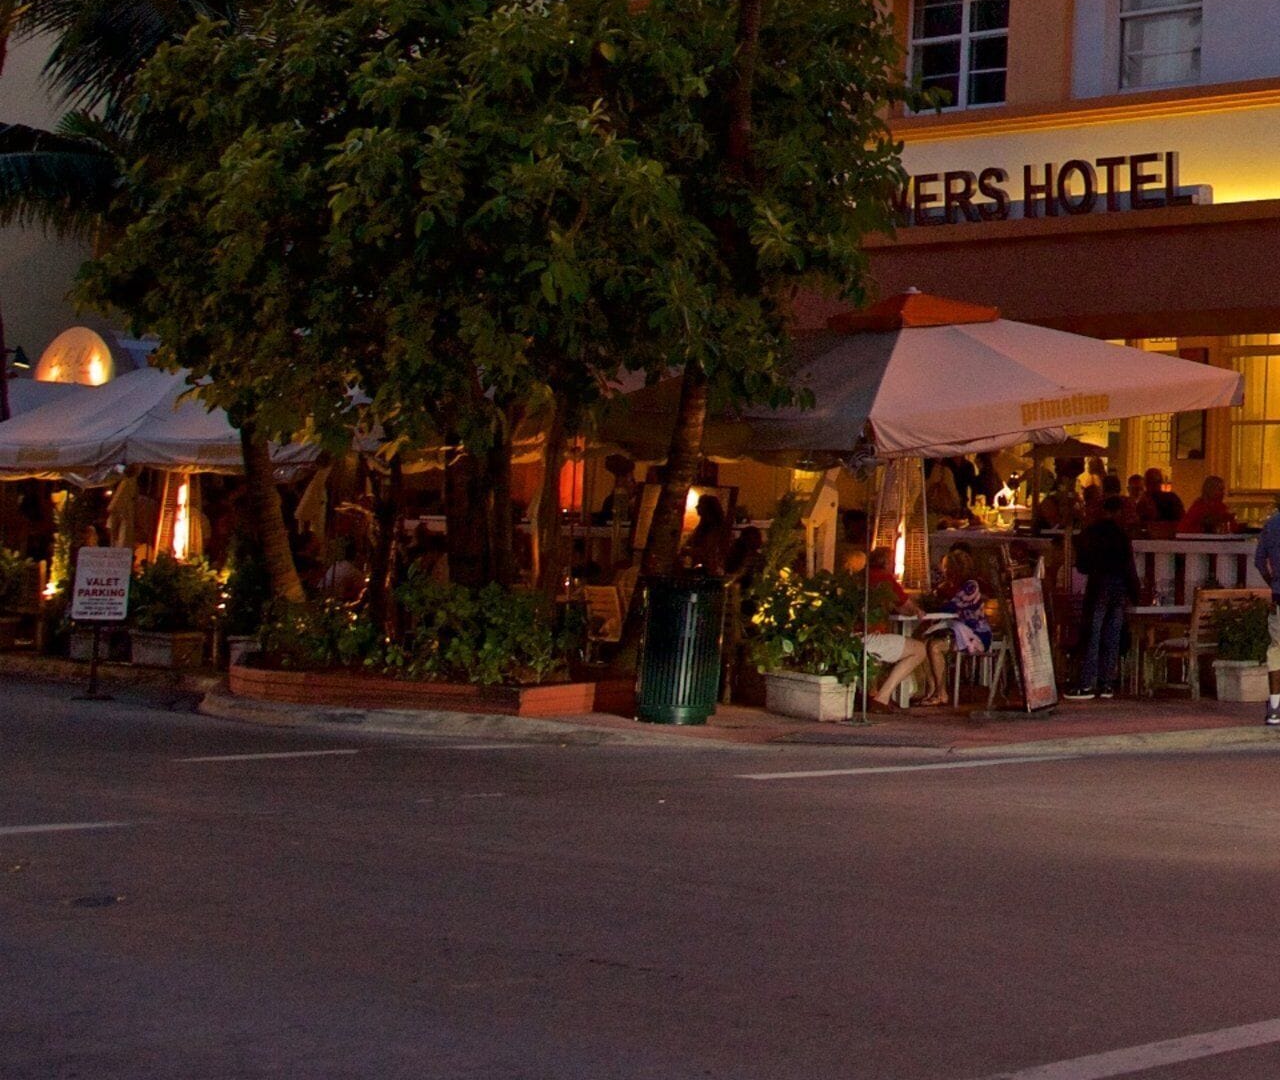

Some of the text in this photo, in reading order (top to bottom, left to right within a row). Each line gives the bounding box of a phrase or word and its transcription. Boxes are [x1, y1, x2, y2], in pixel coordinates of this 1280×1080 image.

[1024, 151, 1193, 219] HOTEL
[86, 577, 120, 586] VALET
[78, 588, 125, 597] PARKING
